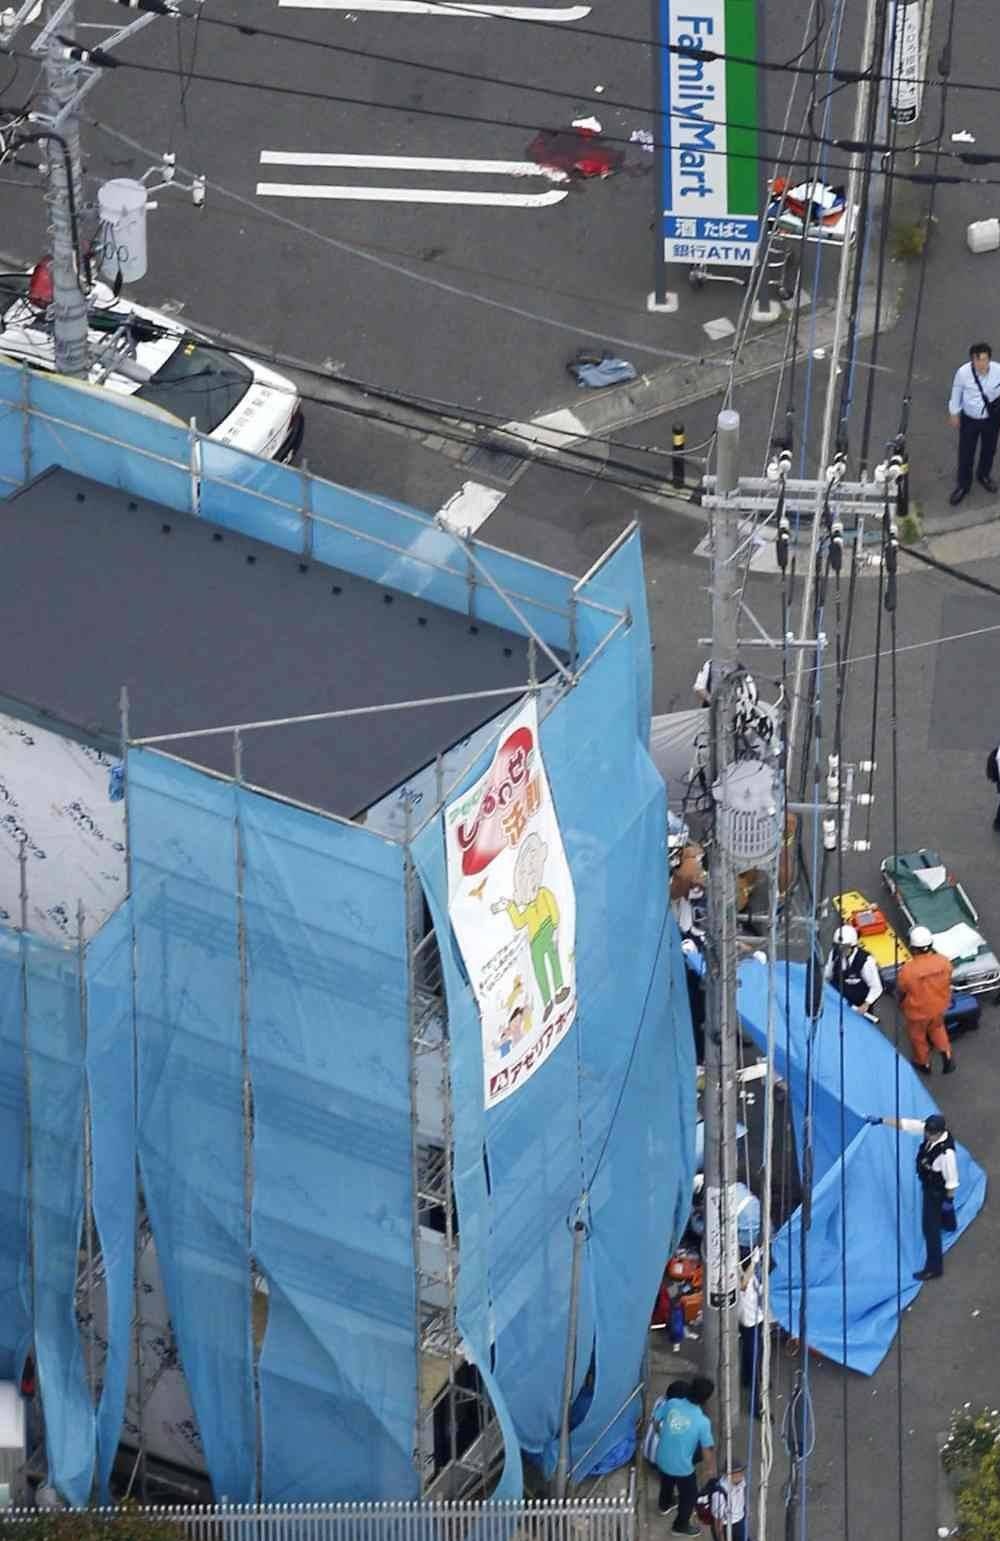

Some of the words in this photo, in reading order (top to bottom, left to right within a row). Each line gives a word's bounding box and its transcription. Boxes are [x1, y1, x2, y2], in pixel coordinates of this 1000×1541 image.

[672, 15, 716, 198] FamilyMart
[703, 221, 749, 239] たばこ
[672, 243, 752, 261] 銀行ATM
